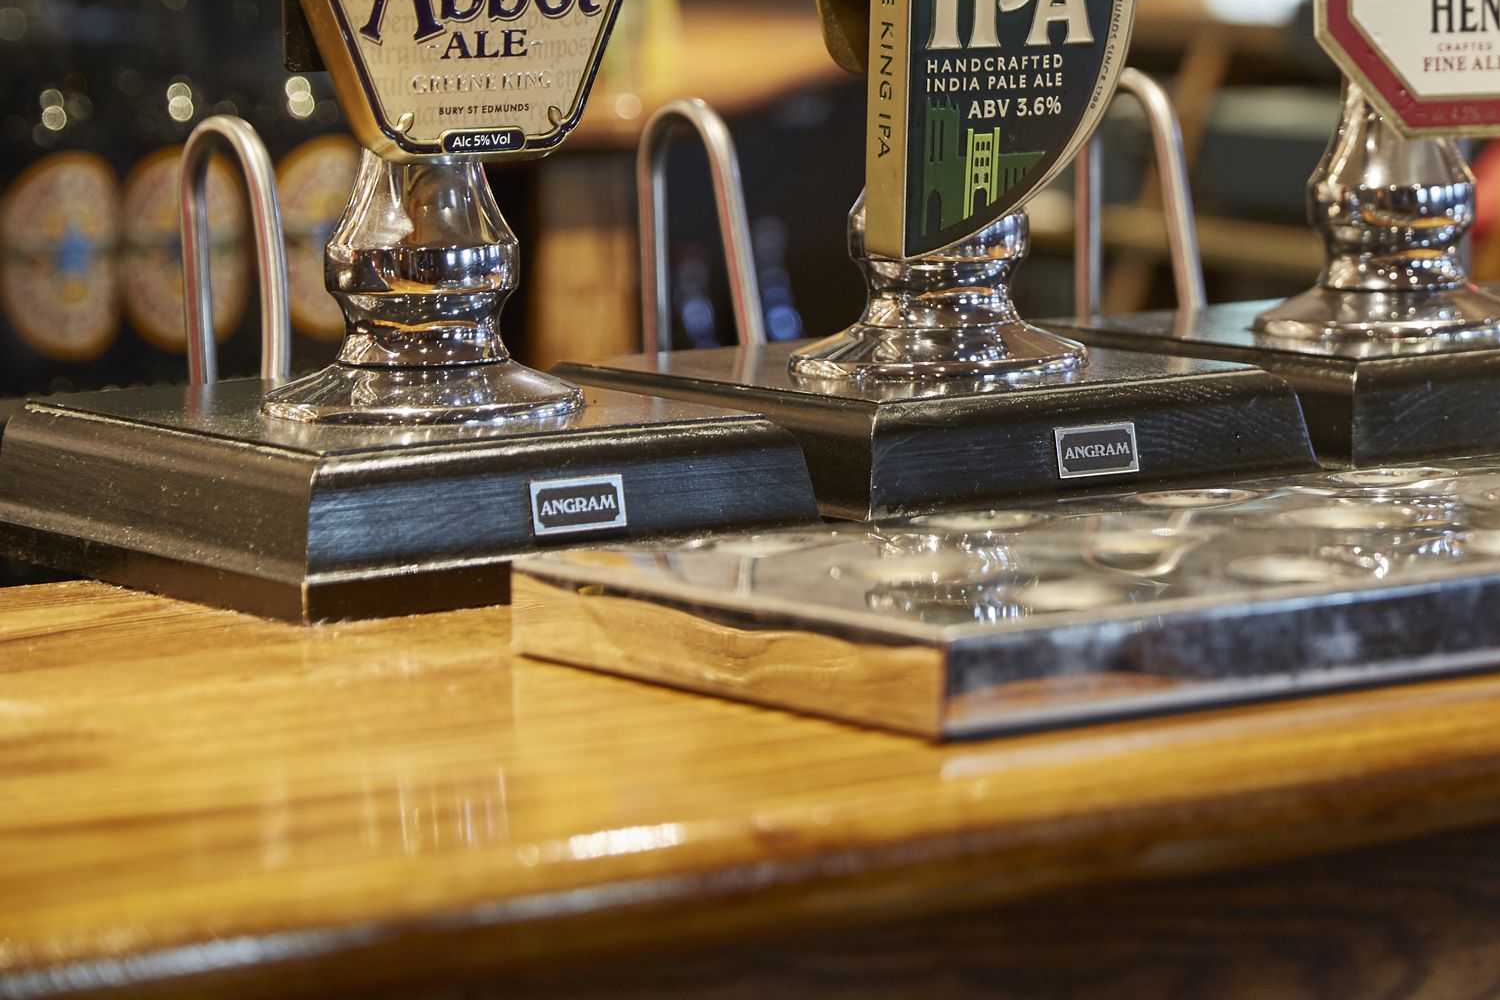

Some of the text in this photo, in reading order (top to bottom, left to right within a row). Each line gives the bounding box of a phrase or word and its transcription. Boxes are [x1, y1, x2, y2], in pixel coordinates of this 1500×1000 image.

[440, 28, 529, 60] ALE
[1437, 41, 1493, 52] CRAFTED
[879, 21, 894, 100] KING
[927, 54, 1063, 74] HANDCRAFTED
[1100, 44, 1114, 81] SINCE
[1423, 56, 1466, 72] FINE
[412, 72, 496, 94] GREENE
[502, 70, 552, 90] KING
[926, 72, 1063, 93] INDIA PALE ALE
[439, 103, 530, 116] BURY ST EDMUNDS
[967, 95, 1062, 119] ABV 3.6%
[453, 132, 511, 148] Alc 5% Vol
[877, 113, 892, 158] IPA
[1065, 441, 1131, 461] ANGRAM
[541, 494, 616, 517] ANGRAM
